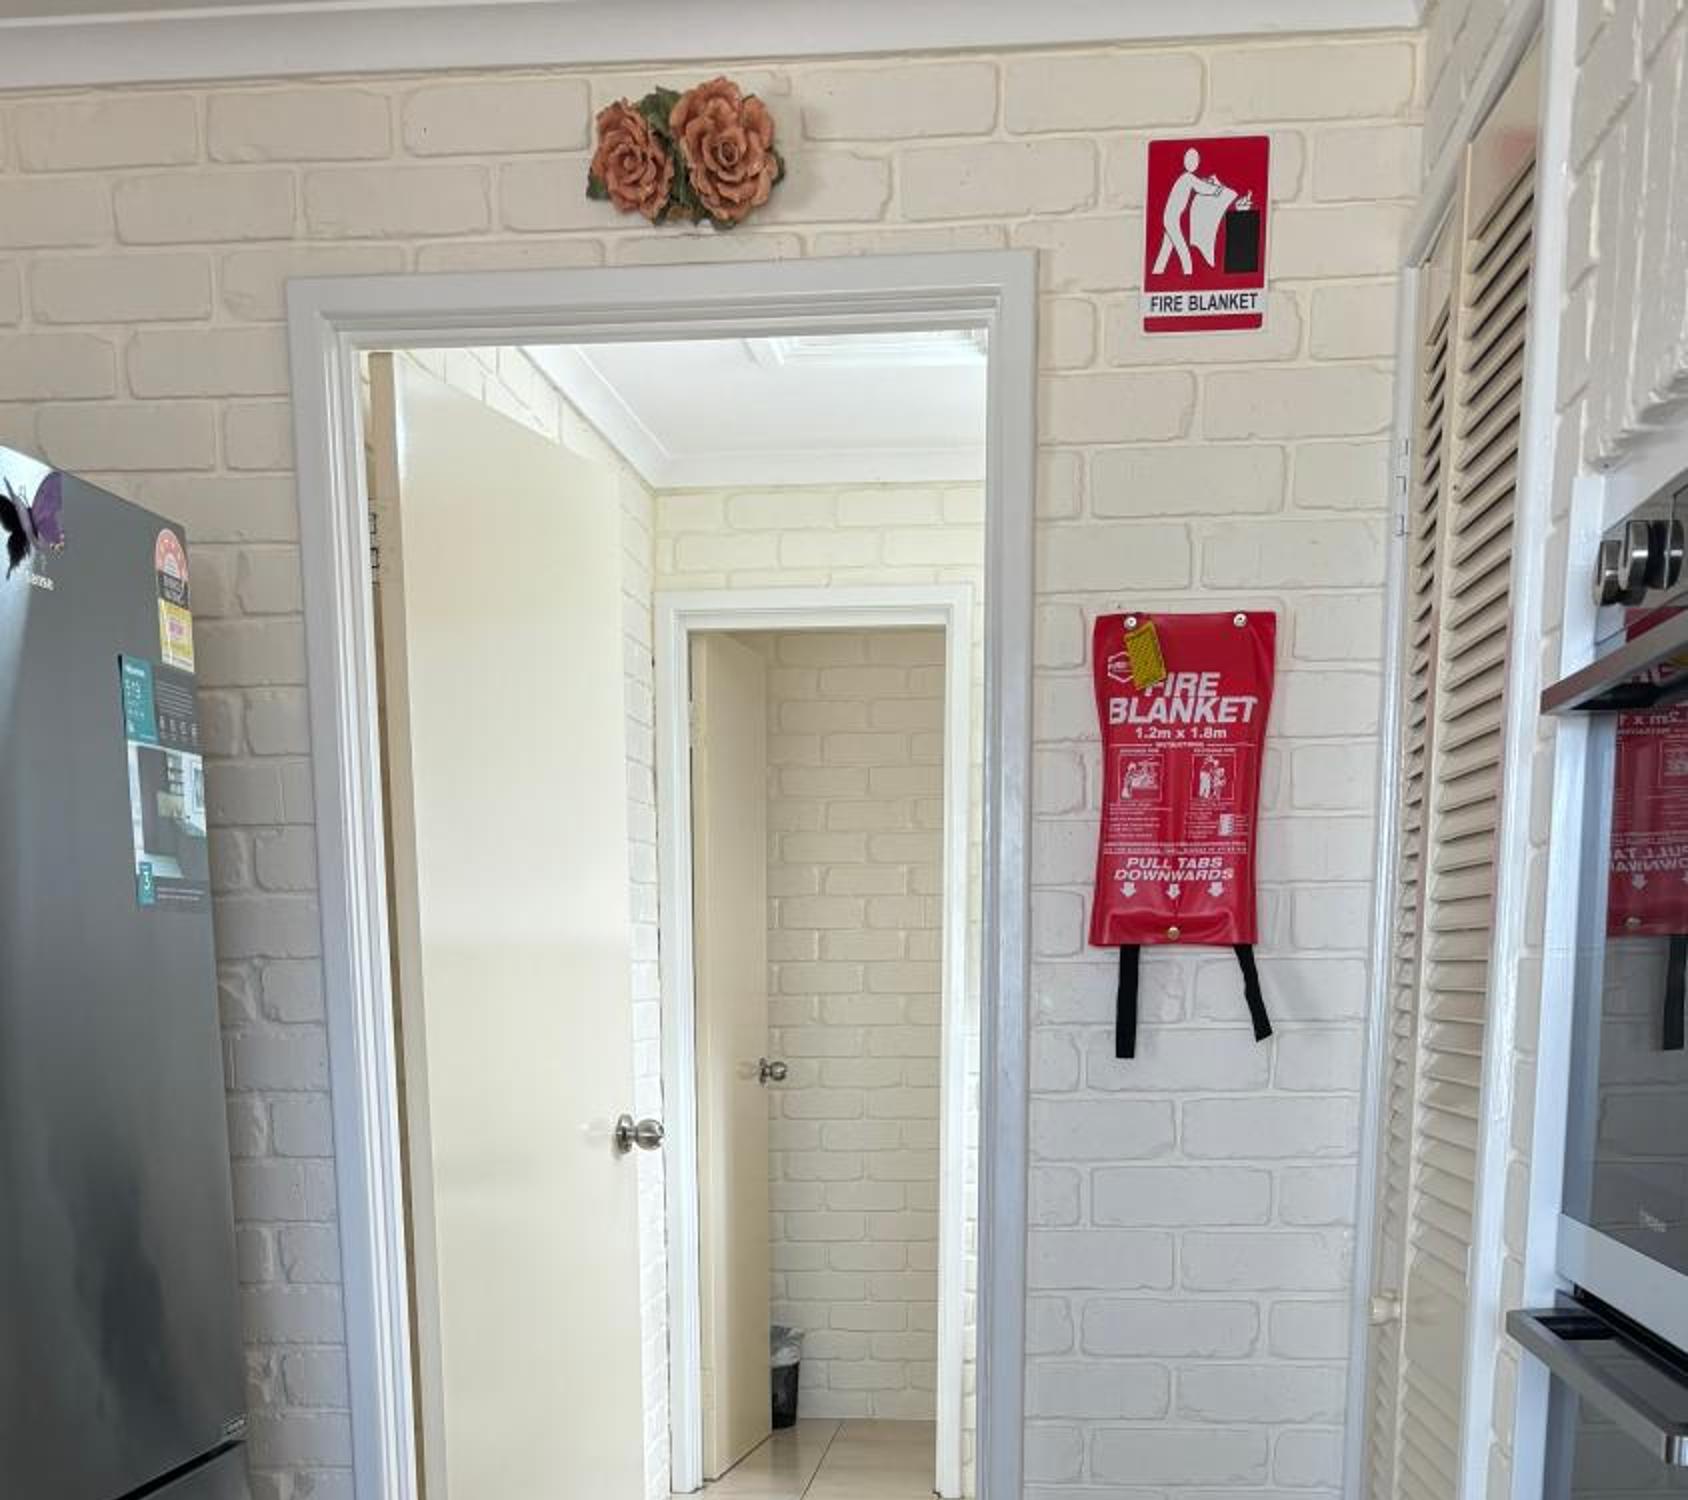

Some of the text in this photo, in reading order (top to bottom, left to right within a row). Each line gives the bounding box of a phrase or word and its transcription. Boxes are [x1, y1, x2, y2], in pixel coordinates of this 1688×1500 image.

[1151, 293, 1259, 312] FIRE BLANKET
[1109, 696, 1258, 724] BLANKET
[1136, 727, 1227, 739] 1.2m x 1.8m
[1126, 857, 1223, 869] PULL TABS
[1114, 868, 1234, 881] DOWNWARDS
